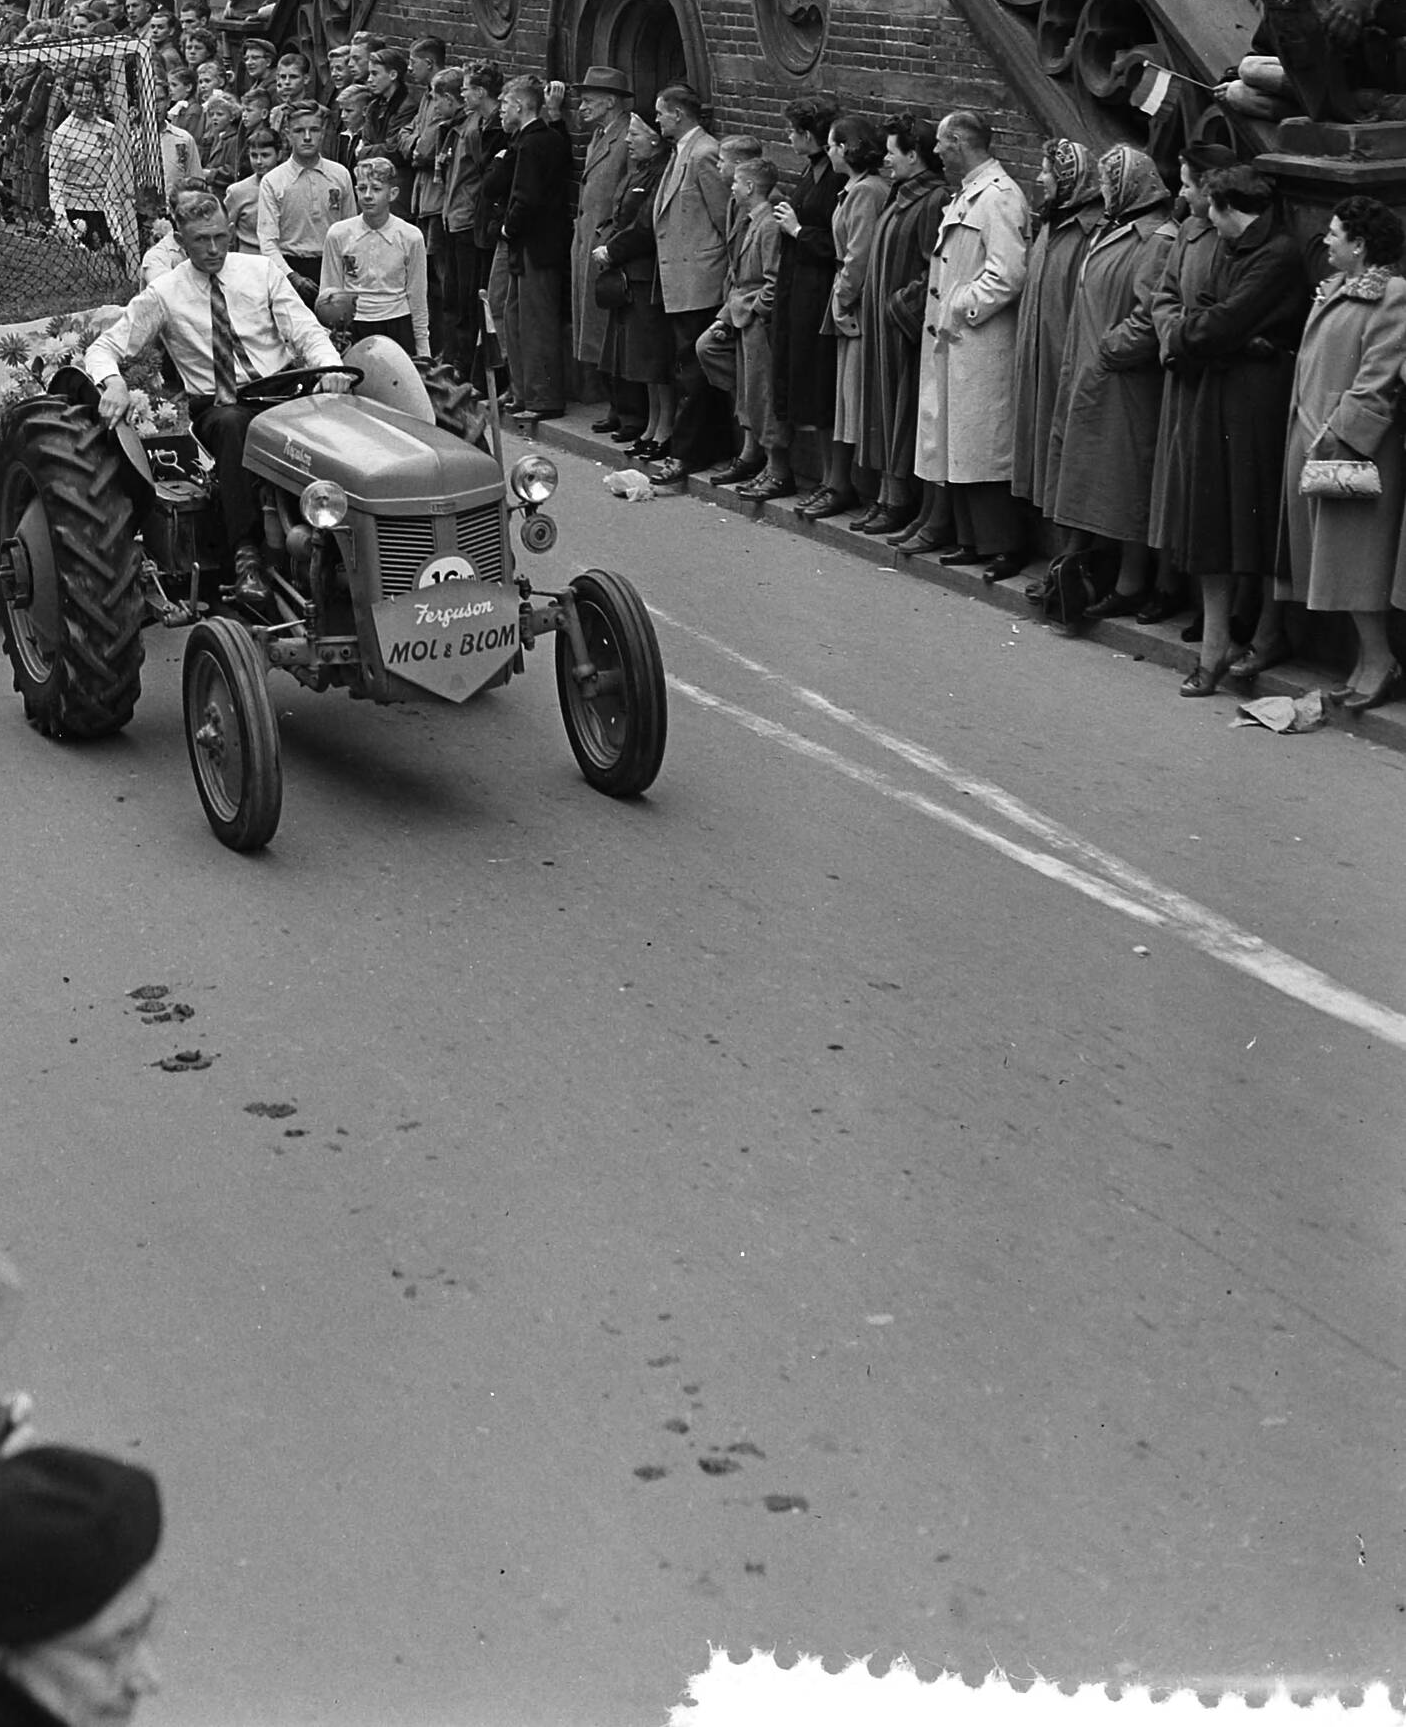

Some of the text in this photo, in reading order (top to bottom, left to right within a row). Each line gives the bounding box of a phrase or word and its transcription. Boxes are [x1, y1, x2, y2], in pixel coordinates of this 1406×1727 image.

[414, 601, 494, 628] Ferguson
[388, 624, 515, 664] MOL & BLOM
